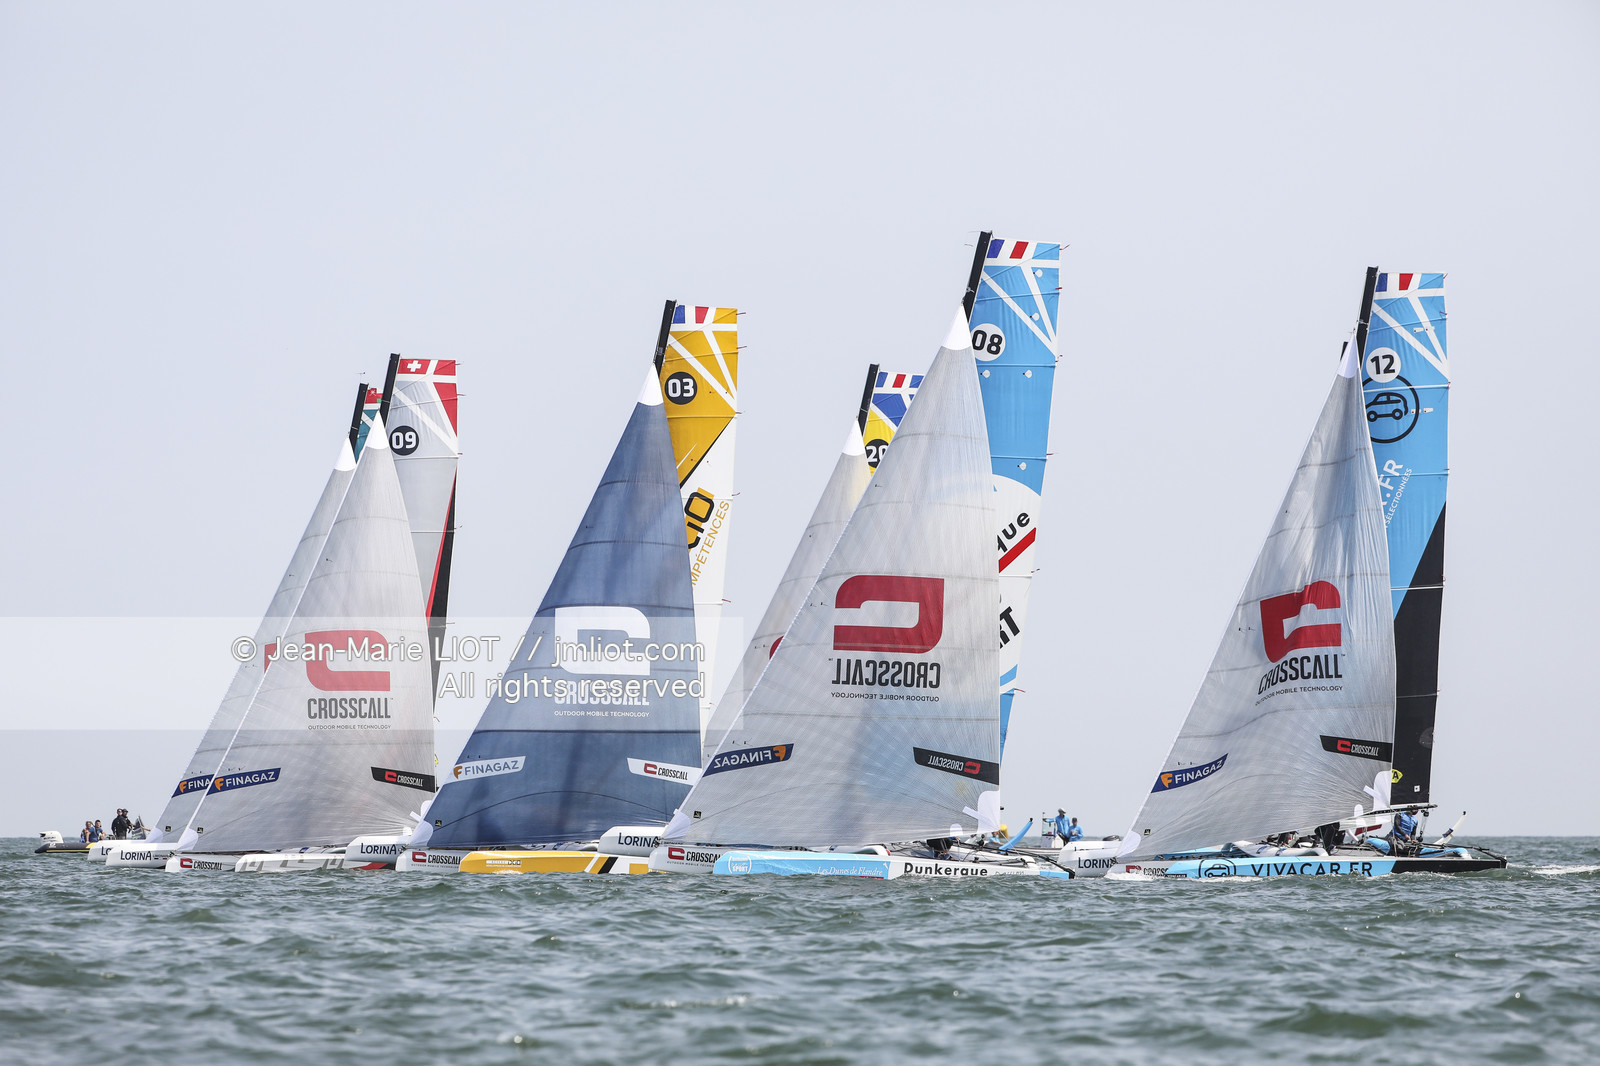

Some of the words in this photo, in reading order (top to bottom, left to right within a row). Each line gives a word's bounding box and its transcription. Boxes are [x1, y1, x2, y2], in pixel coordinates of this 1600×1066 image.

[972, 329, 1003, 355] 08
[1370, 354, 1396, 375] 12
[667, 378, 695, 398] 03
[391, 431, 417, 450] 09
[1378, 459, 1404, 506] .FR
[1257, 653, 1343, 696] CROSSCALL
[1276, 687, 1298, 696] MOBILE
[307, 697, 391, 719] CROSSCALL
[1351, 744, 1379, 757] CROSSCALL
[464, 759, 520, 776] FINAGAZ
[657, 767, 688, 781] CROSSCALL
[1174, 759, 1223, 784] FINAGAZ
[226, 771, 276, 787] FINAGAZ
[397, 774, 424, 787] CROSSCALL
[120, 850, 152, 861] LORINA
[361, 842, 397, 855] LORINA
[193, 860, 223, 871] CROSSCALL
[1078, 857, 1114, 868] LORIN
[1251, 861, 1373, 877] VIVACARFR
[830, 866, 850, 875] Dunes
[858, 866, 883, 876] Flandre
